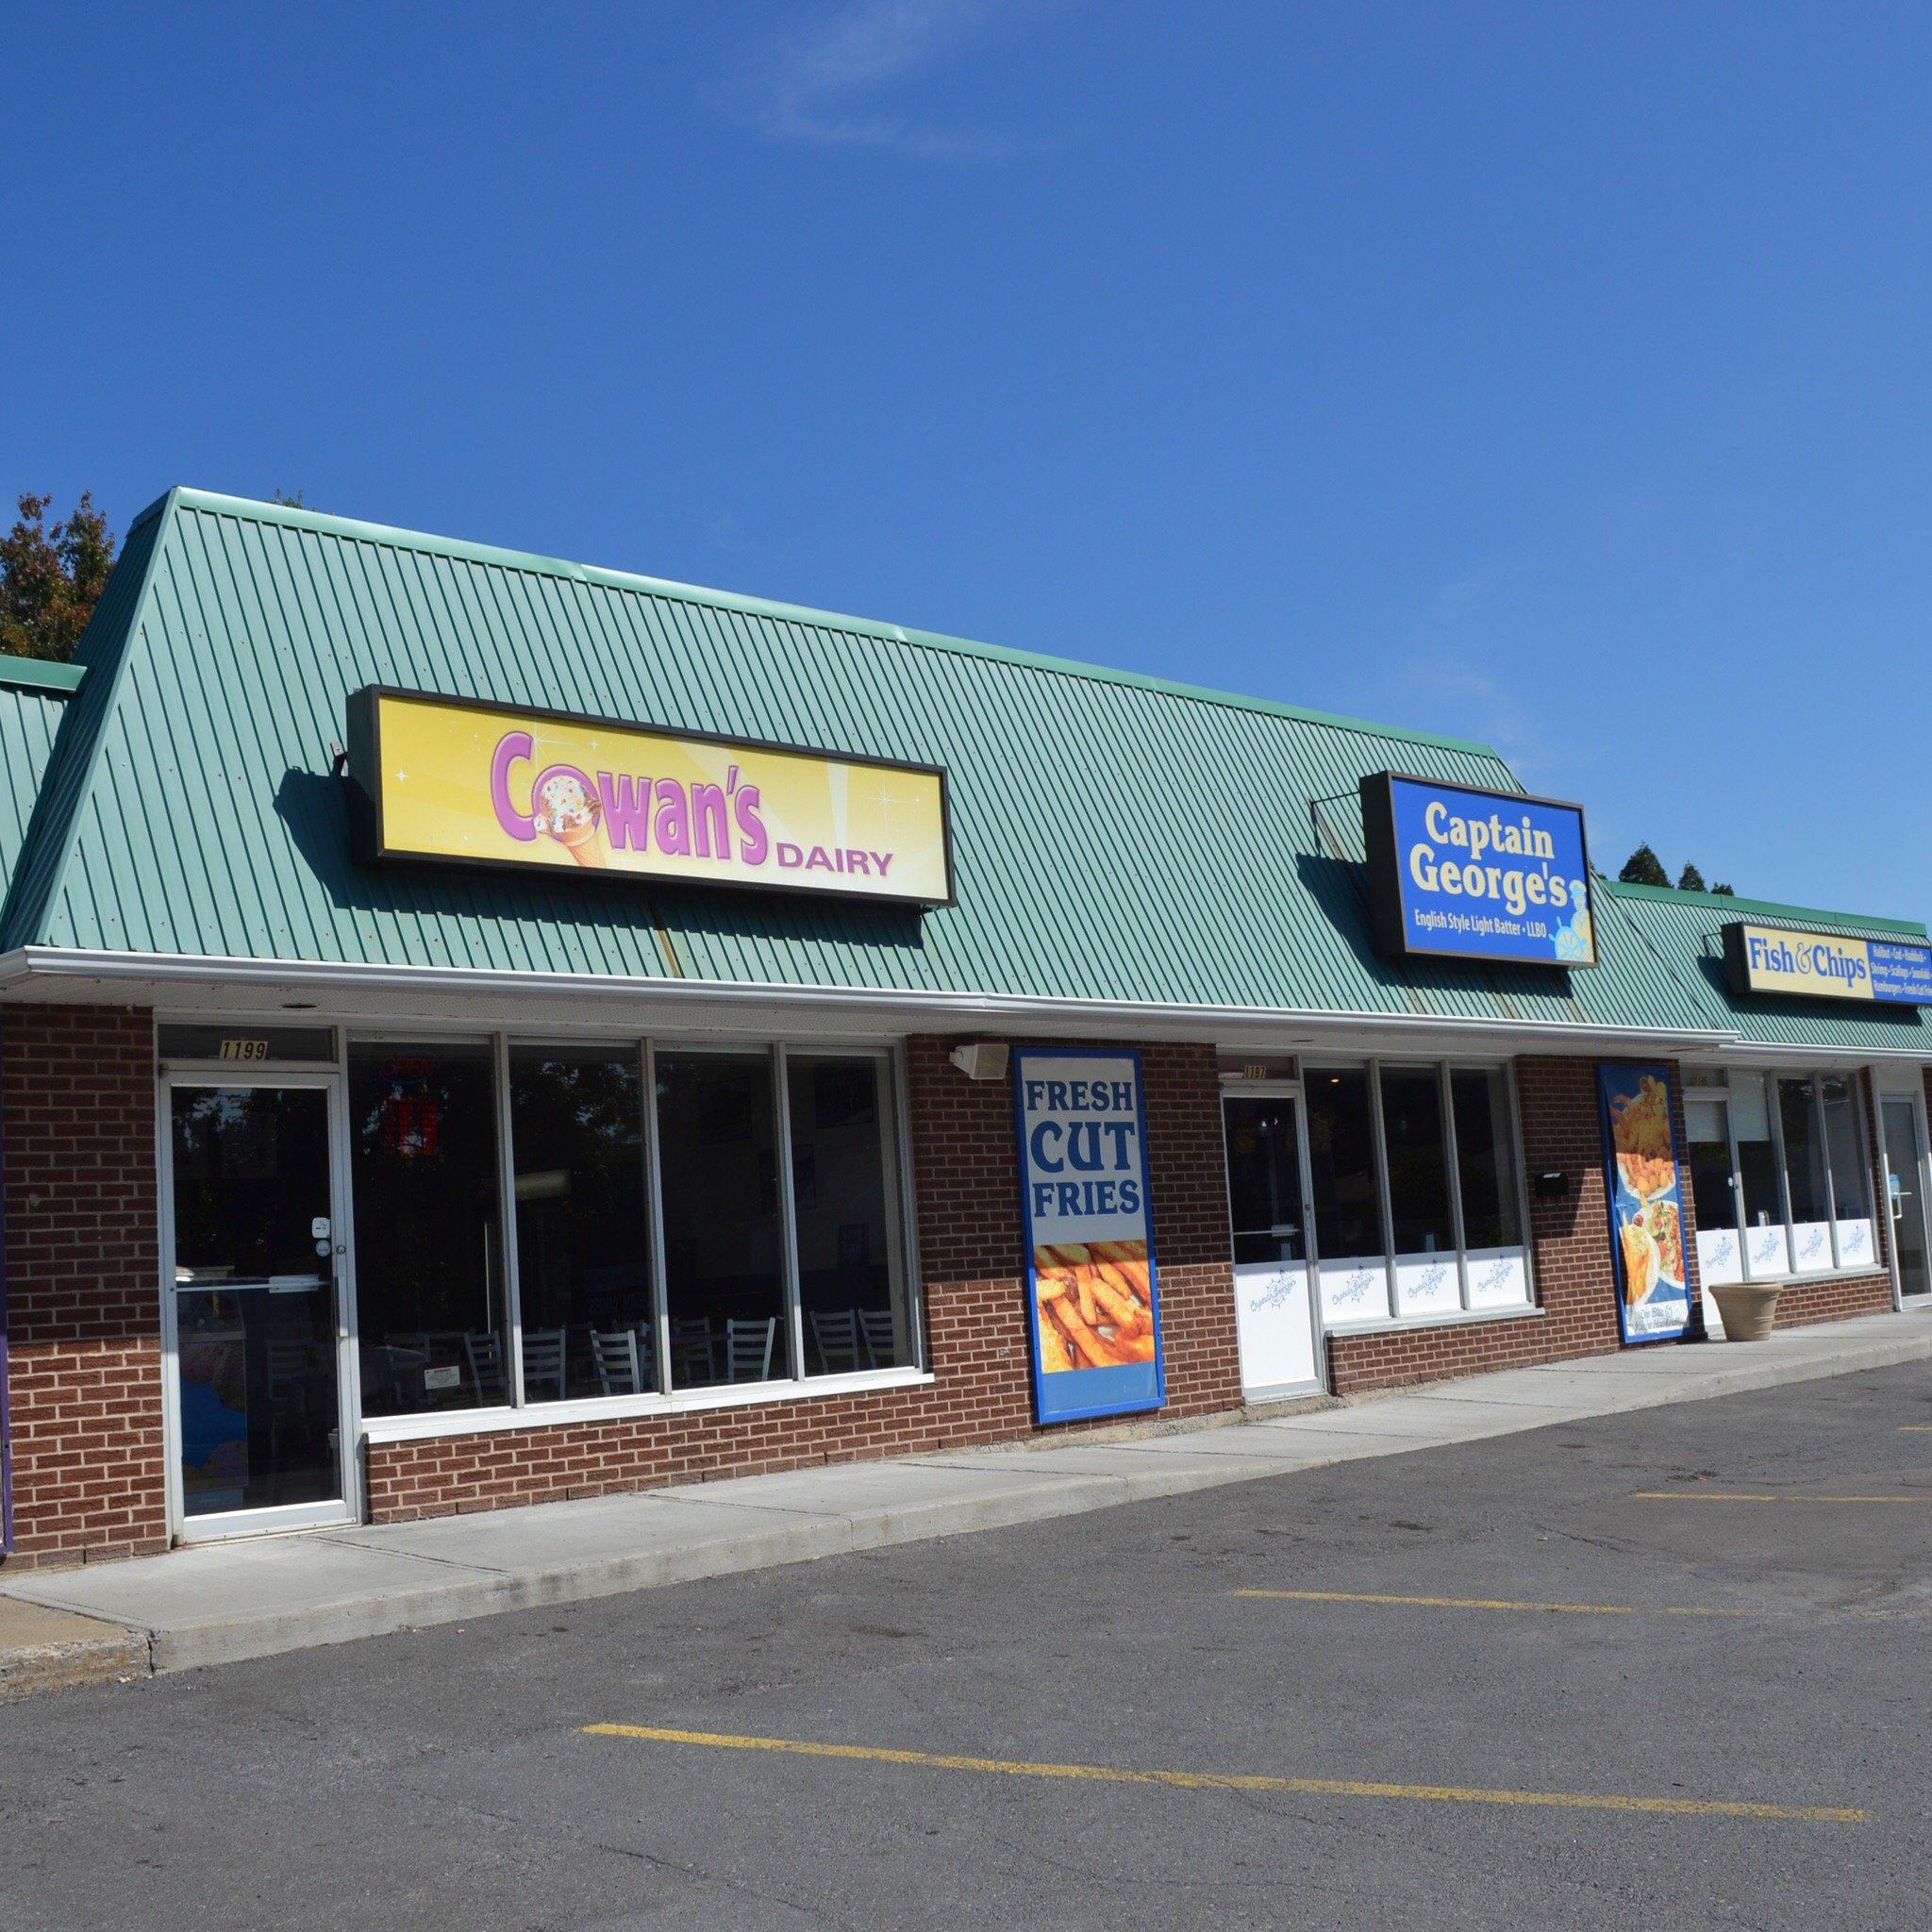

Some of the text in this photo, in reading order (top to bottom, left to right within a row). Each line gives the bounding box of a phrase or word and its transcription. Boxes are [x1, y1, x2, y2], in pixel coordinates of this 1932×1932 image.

[491, 731, 893, 877] Cowan's DAIRY
[1425, 802, 1555, 860] Captain
[1409, 843, 1568, 916] George's
[1415, 909, 1447, 931] English
[1448, 912, 1471, 934] Style
[1472, 915, 1493, 937] Light
[1495, 918, 1521, 936] Batter
[1748, 938, 1795, 973] Fish
[1795, 941, 1812, 975] &
[1812, 944, 1867, 988] Chips
[224, 1041, 265, 1059] 1199
[1025, 1080, 1134, 1112] FRESH
[1030, 1120, 1136, 1174] CUT
[1032, 1179, 1141, 1218] FRIES
